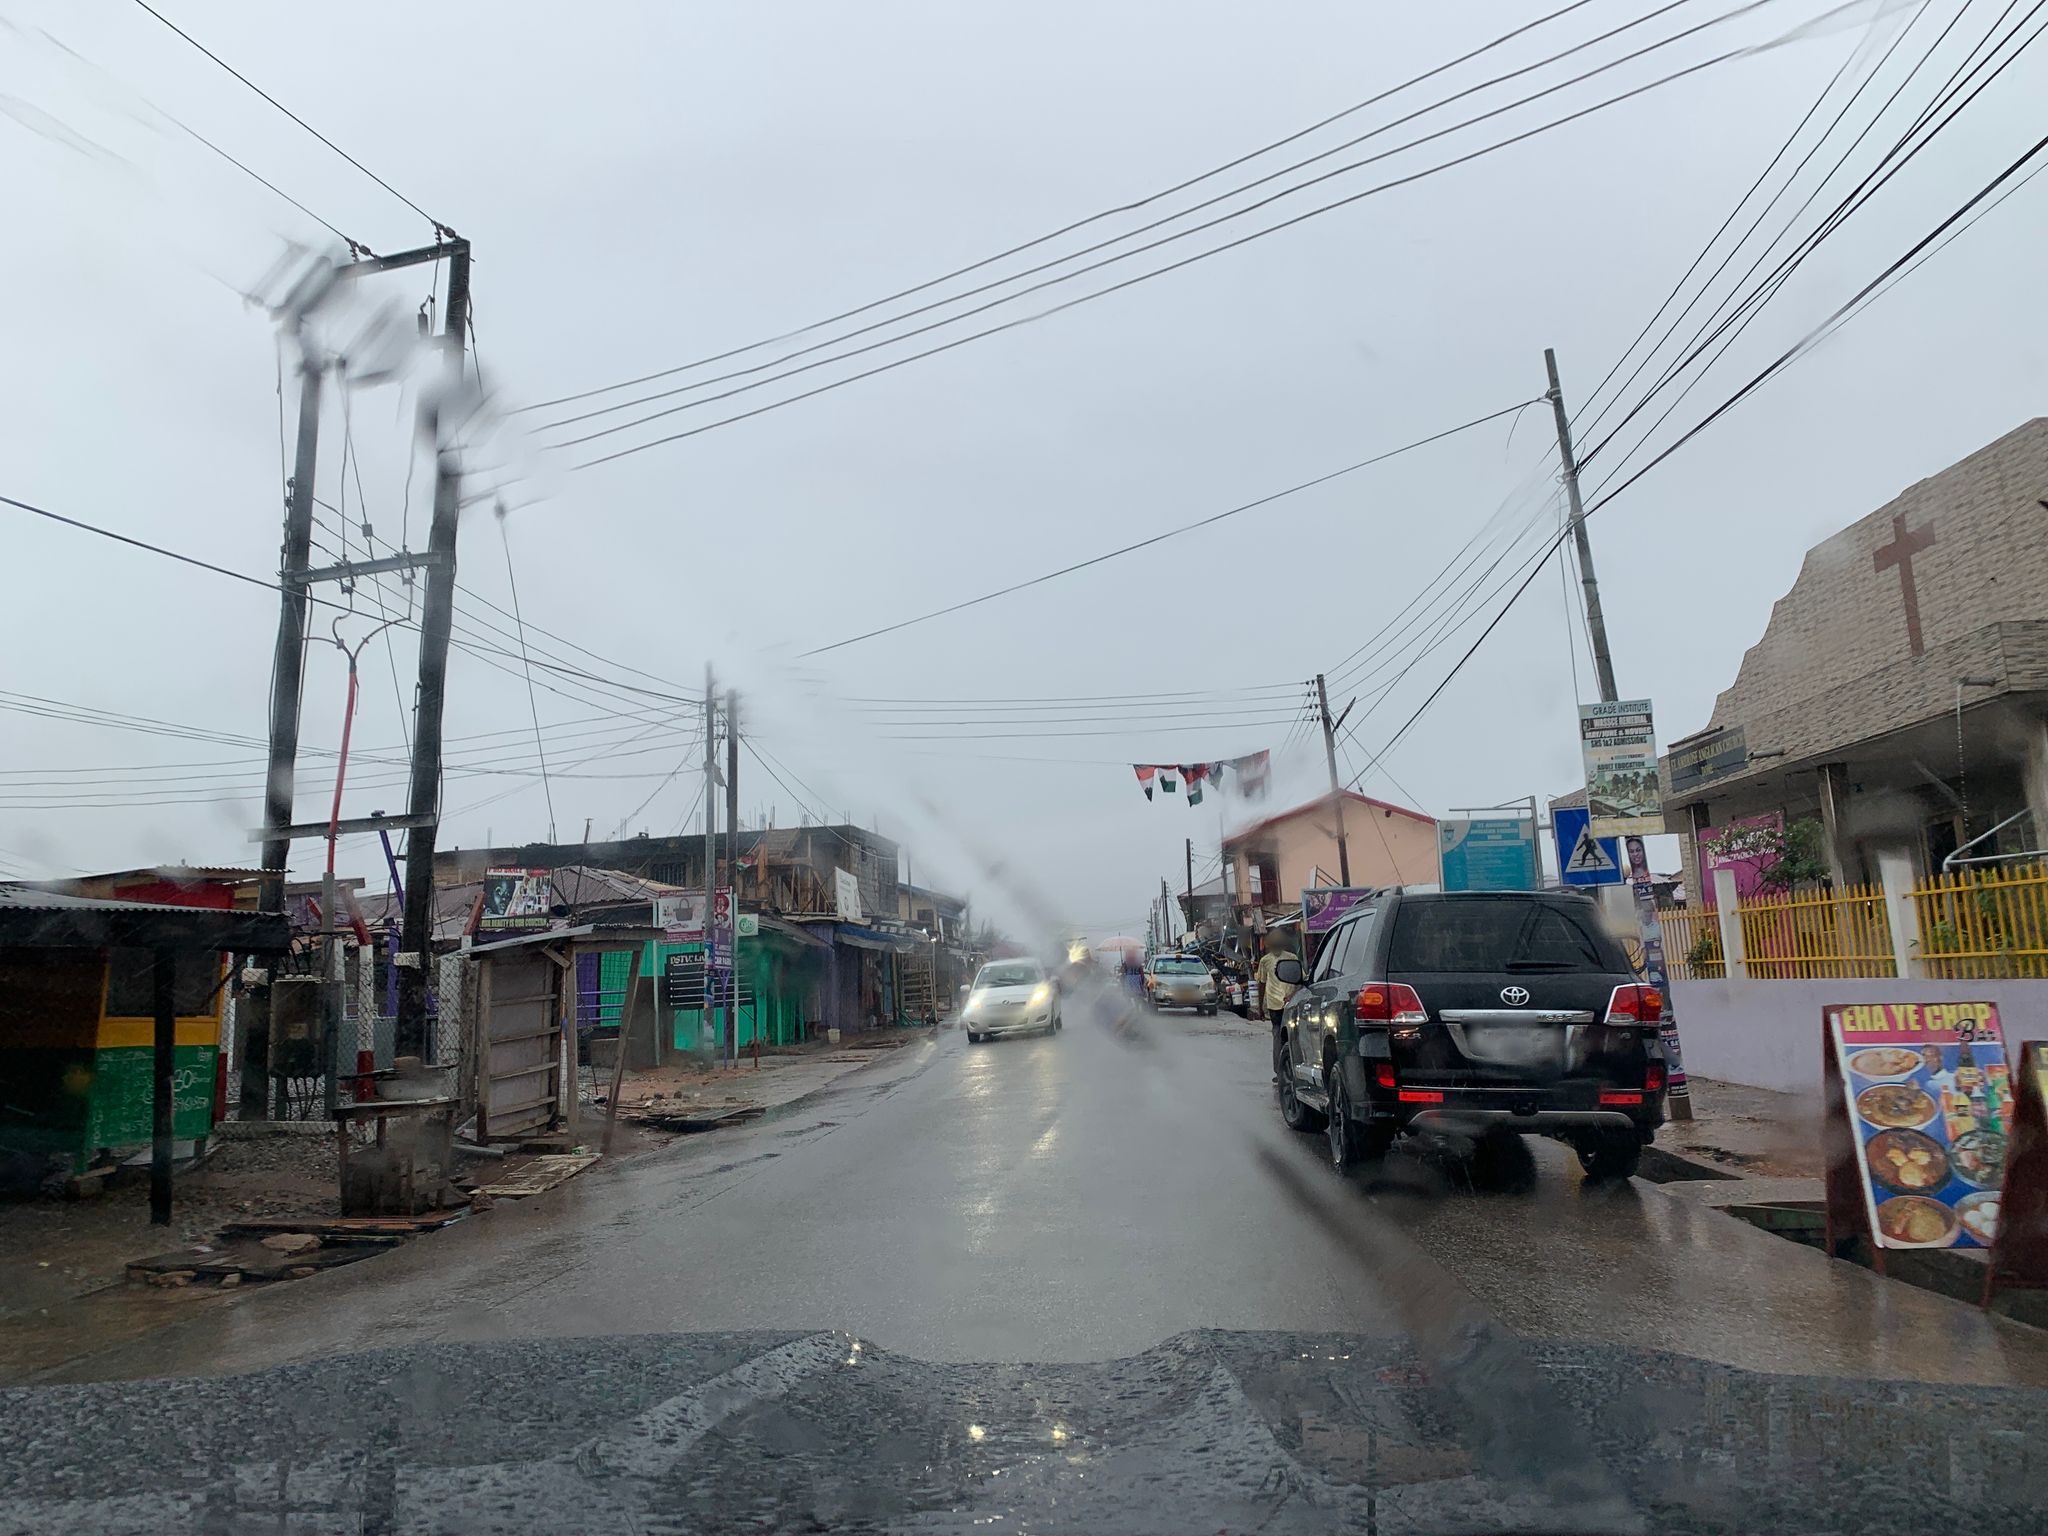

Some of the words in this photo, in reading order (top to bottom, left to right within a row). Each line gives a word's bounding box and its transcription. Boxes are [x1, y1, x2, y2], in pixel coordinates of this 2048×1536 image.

[1592, 704, 1617, 716] GRADE
[1617, 702, 1649, 713] INSTITUTE
[1613, 735, 1647, 746] ADMISSIONS
[1614, 761, 1646, 769] EDUCATION
[492, 919, 509, 927] BEAUTY
[1842, 1004, 1890, 1032] EHA
[1889, 1004, 1922, 1031] YE
[1923, 1003, 1992, 1031] CHOP
